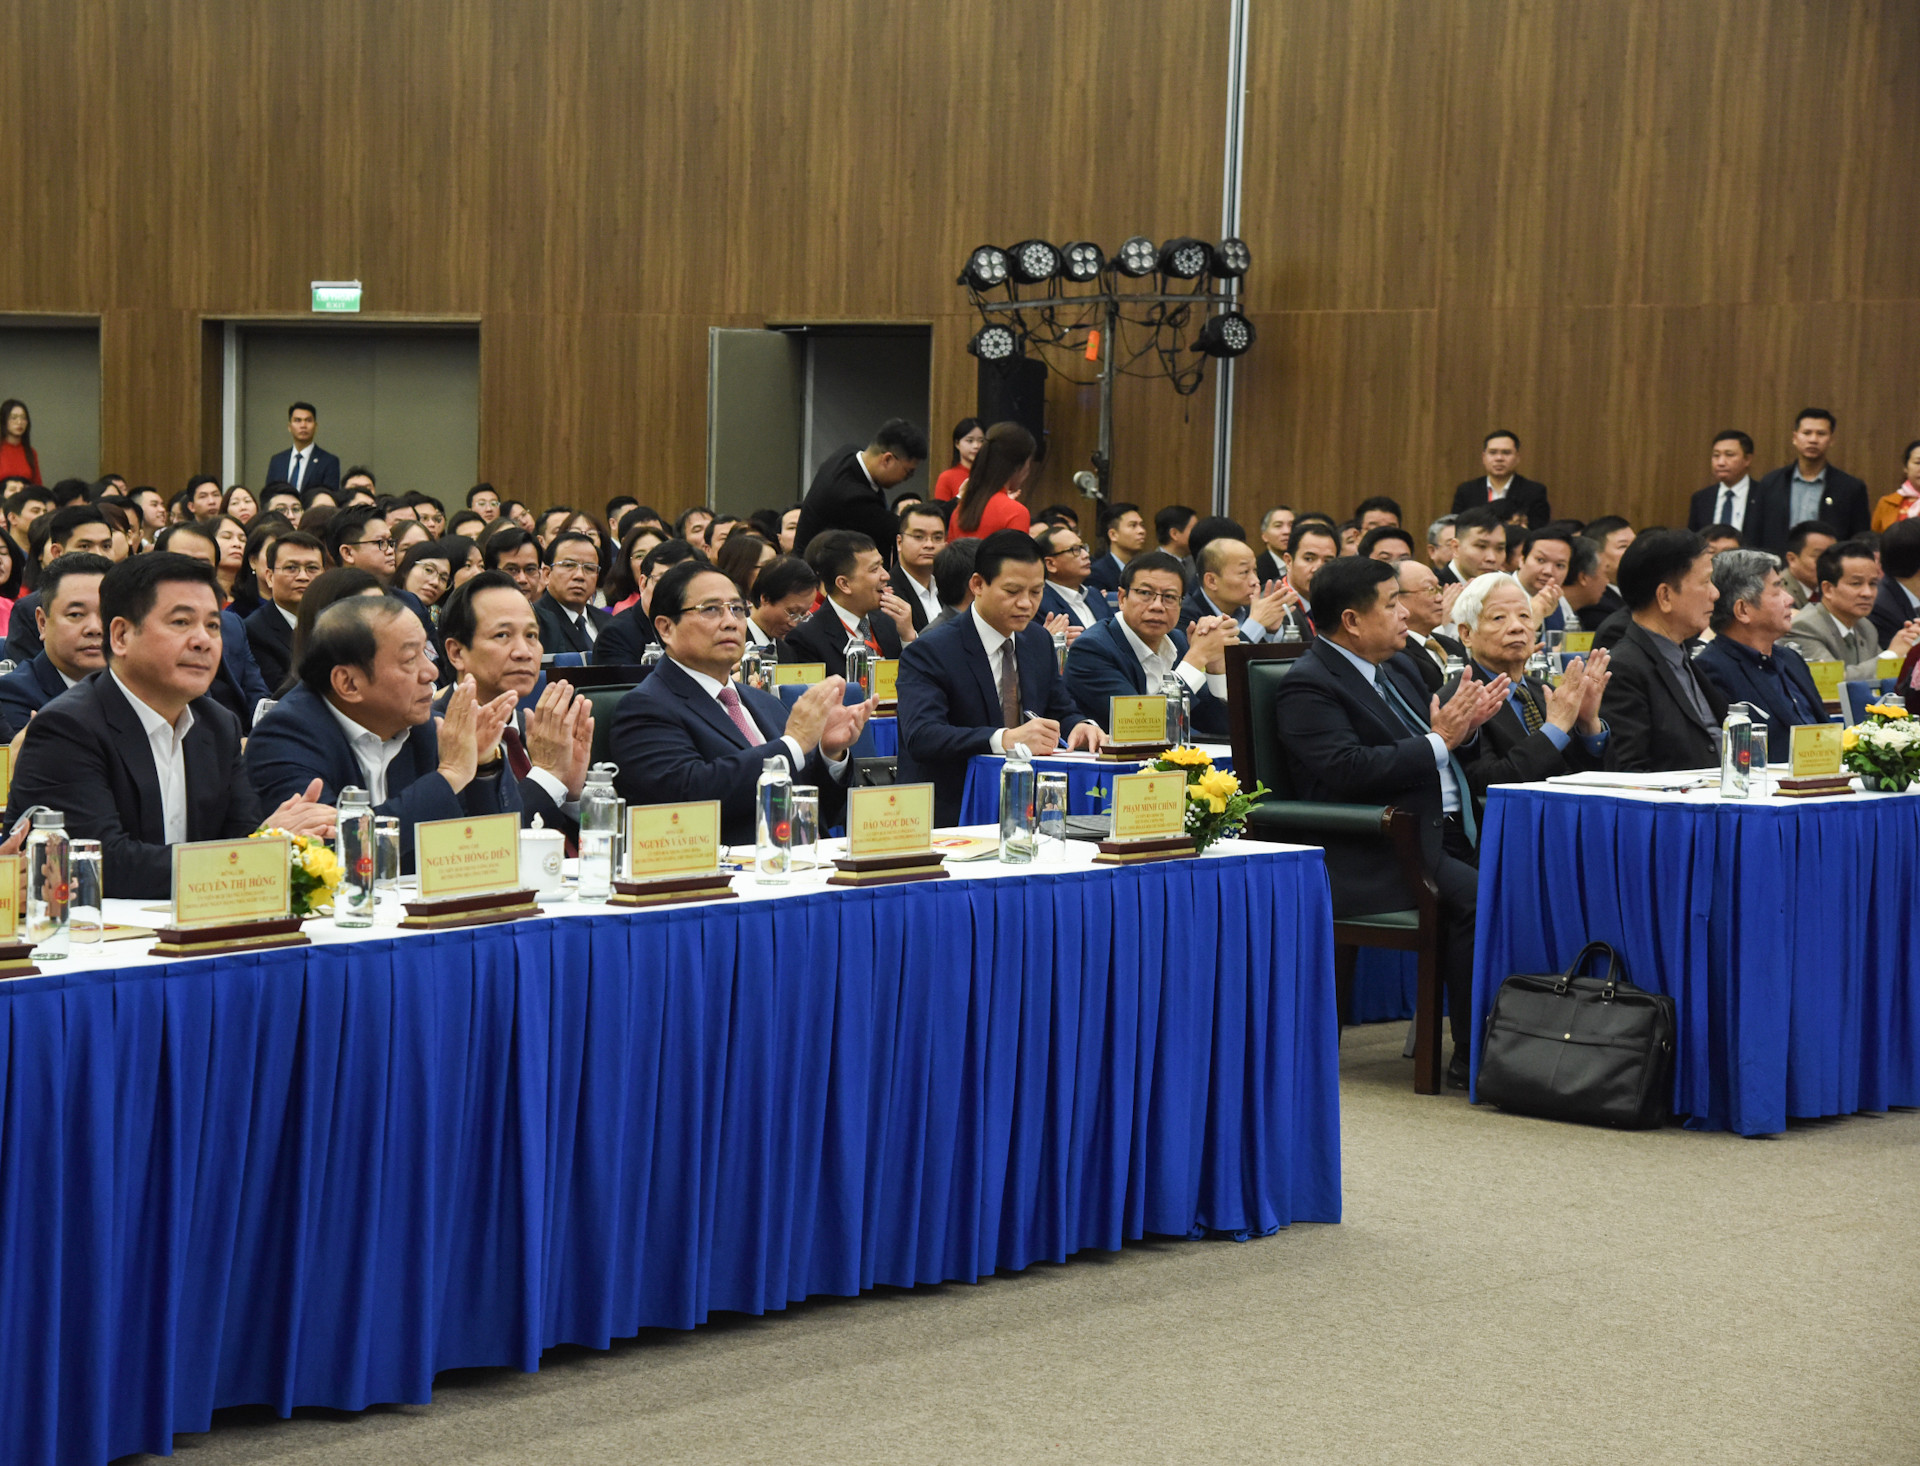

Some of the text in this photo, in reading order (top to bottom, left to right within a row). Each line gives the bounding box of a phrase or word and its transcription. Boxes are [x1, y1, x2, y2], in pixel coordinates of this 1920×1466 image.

[1123, 801, 1177, 814] PHẠM MINH CHÍNH
[880, 819, 899, 830] NGỌC
[639, 837, 670, 849] NGUYỄN
[671, 836, 687, 847] VĂN
[426, 853, 462, 867] NGUYỄN
[464, 850, 489, 863] HỒNG
[188, 875, 276, 894] NGUYỄN THỊ HỒNG
